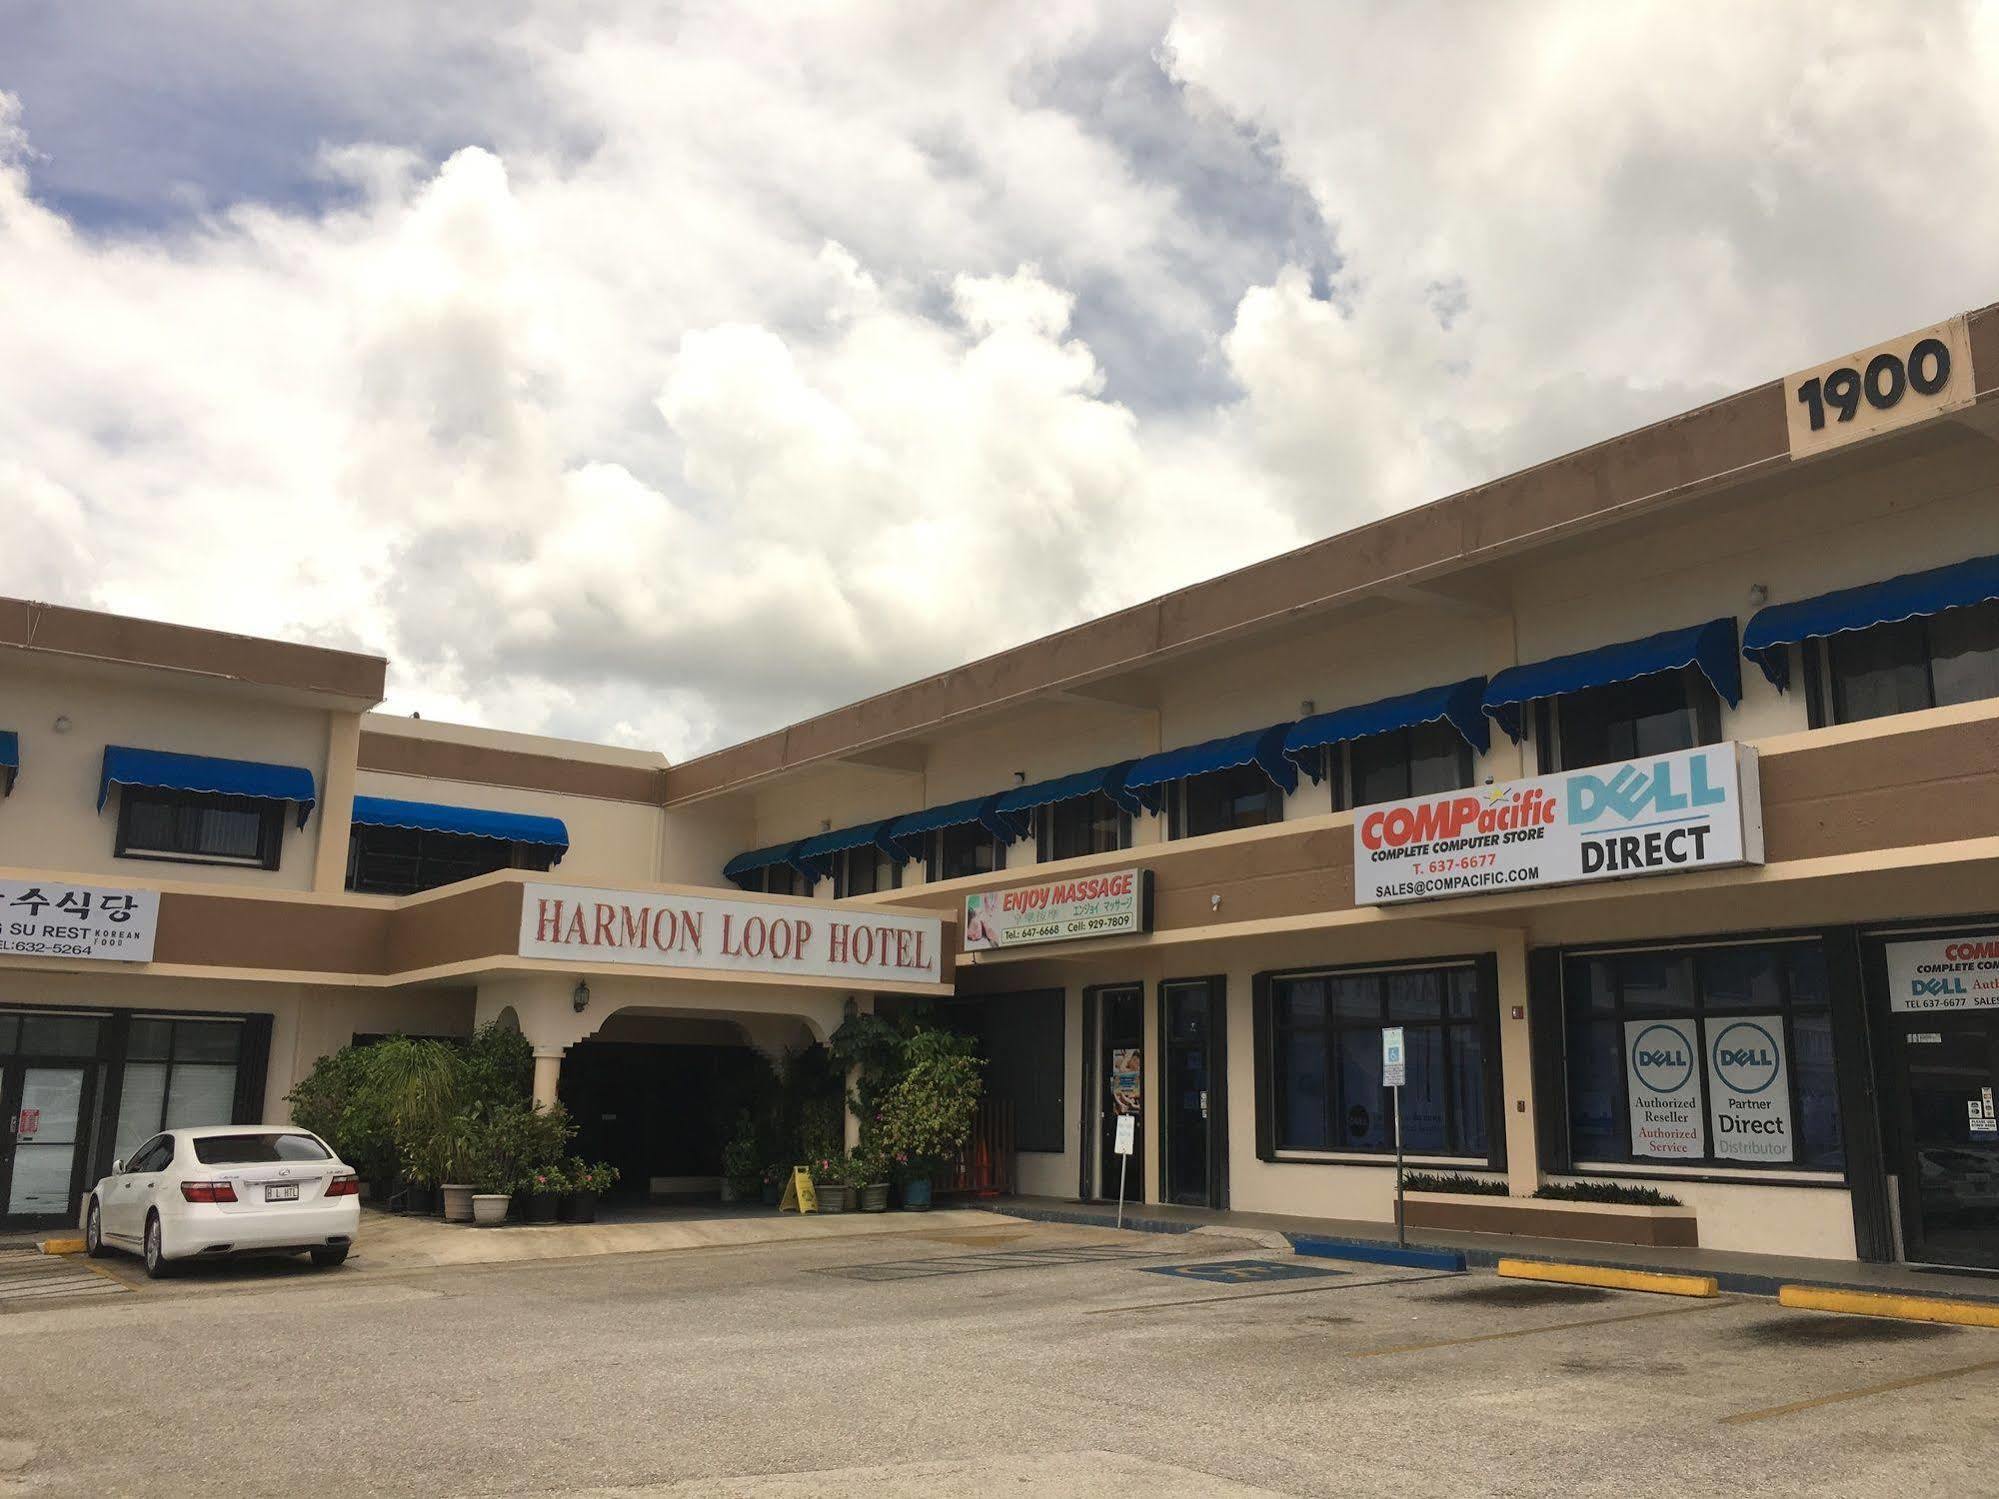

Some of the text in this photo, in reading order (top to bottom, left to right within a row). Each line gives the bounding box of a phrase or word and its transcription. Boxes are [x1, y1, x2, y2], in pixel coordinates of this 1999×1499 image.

[1798, 338, 1951, 431] 1900
[1567, 754, 1726, 825] DELL
[1361, 788, 1557, 850] COMPacific
[1371, 827, 1545, 862] COMPLETE COMPUTER STORE
[1581, 825, 1711, 874] DIRECT
[1413, 853, 1497, 875] T. 637-6677
[1376, 867, 1540, 897] SALES@COMPACIFIC.COM
[1003, 874, 1134, 914] ENJOY MASSAGE
[0, 887, 139, 922] 수식당
[10, 922, 35, 936] SU
[42, 925, 91, 939] REST
[95, 929, 140, 939] KOREAN
[535, 898, 933, 970] HARMON LOOP HOTEL
[1022, 925, 1060, 938] 647-6668
[1067, 920, 1086, 932] Cell:
[1088, 915, 1130, 929] 929-7809
[1917, 962, 1974, 973] COMPLETE
[1911, 977, 1967, 996] DELL
[1905, 1000, 1920, 1008] TEL
[1923, 998, 1966, 1007] 637-6677
[1639, 1050, 1686, 1067] DELL
[1720, 1048, 1772, 1067] DELL
[1635, 1096, 1696, 1108] Authorized
[1728, 1098, 1772, 1109] Partner
[1645, 1111, 1688, 1123] Reseller
[1718, 1114, 1784, 1134] Direct
[1638, 1127, 1697, 1139] Authorized
[1649, 1141, 1688, 1153] Service
[1719, 1140, 1787, 1155] Distributor
